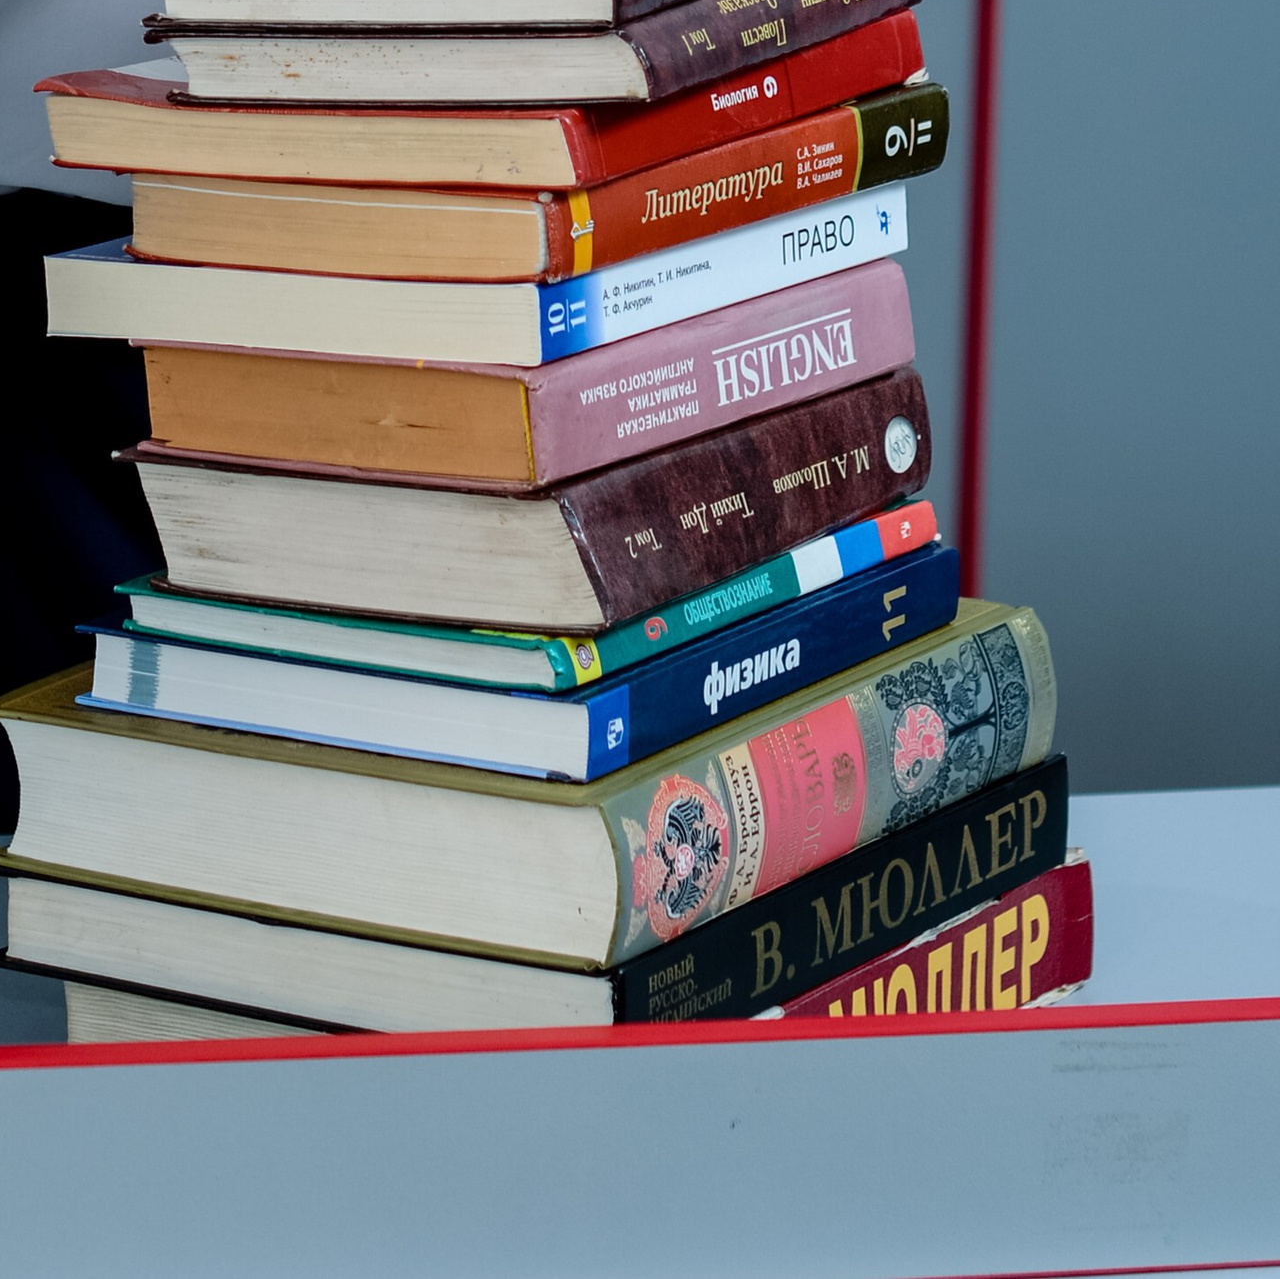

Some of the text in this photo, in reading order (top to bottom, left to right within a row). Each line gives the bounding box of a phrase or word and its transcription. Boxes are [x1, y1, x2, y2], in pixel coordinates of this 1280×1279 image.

[681, 28, 716, 56] Том 1
[741, 18, 787, 46] Повести
[710, 85, 759, 111] Биология
[812, 168, 843, 186] Чалмаев
[813, 153, 843, 172] Сахаров
[641, 161, 784, 224] Литература
[782, 214, 855, 265] ПРАВО
[623, 276, 657, 295] Никитин,
[675, 259, 712, 279] Никитина,
[548, 301, 566, 337] 10
[569, 299, 587, 328] 11
[623, 294, 653, 314] Акчурин
[580, 357, 695, 406] АНГЛИЙСКОГО ЯЗЫКА
[713, 319, 857, 407] ENGLISH
[628, 378, 697, 412] ГРАММАТИКА
[617, 400, 700, 438] ПРАКТИЧЕСКАЯ
[773, 460, 830, 494] Шолохов
[680, 492, 755, 534] Тихий Дон
[625, 527, 662, 559] Том 2
[683, 572, 773, 626] ОБЩЕСТВОЗНАНИЕ
[882, 585, 907, 642] 11
[703, 638, 801, 715] физика
[724, 754, 750, 855] Брокгауз
[740, 763, 762, 836] Ефрон
[791, 719, 826, 875] СЛОВАРЬ
[750, 920, 796, 999] В.
[810, 789, 1048, 969] МЮЛЛЕР
[649, 953, 695, 993] НОВЫЙ
